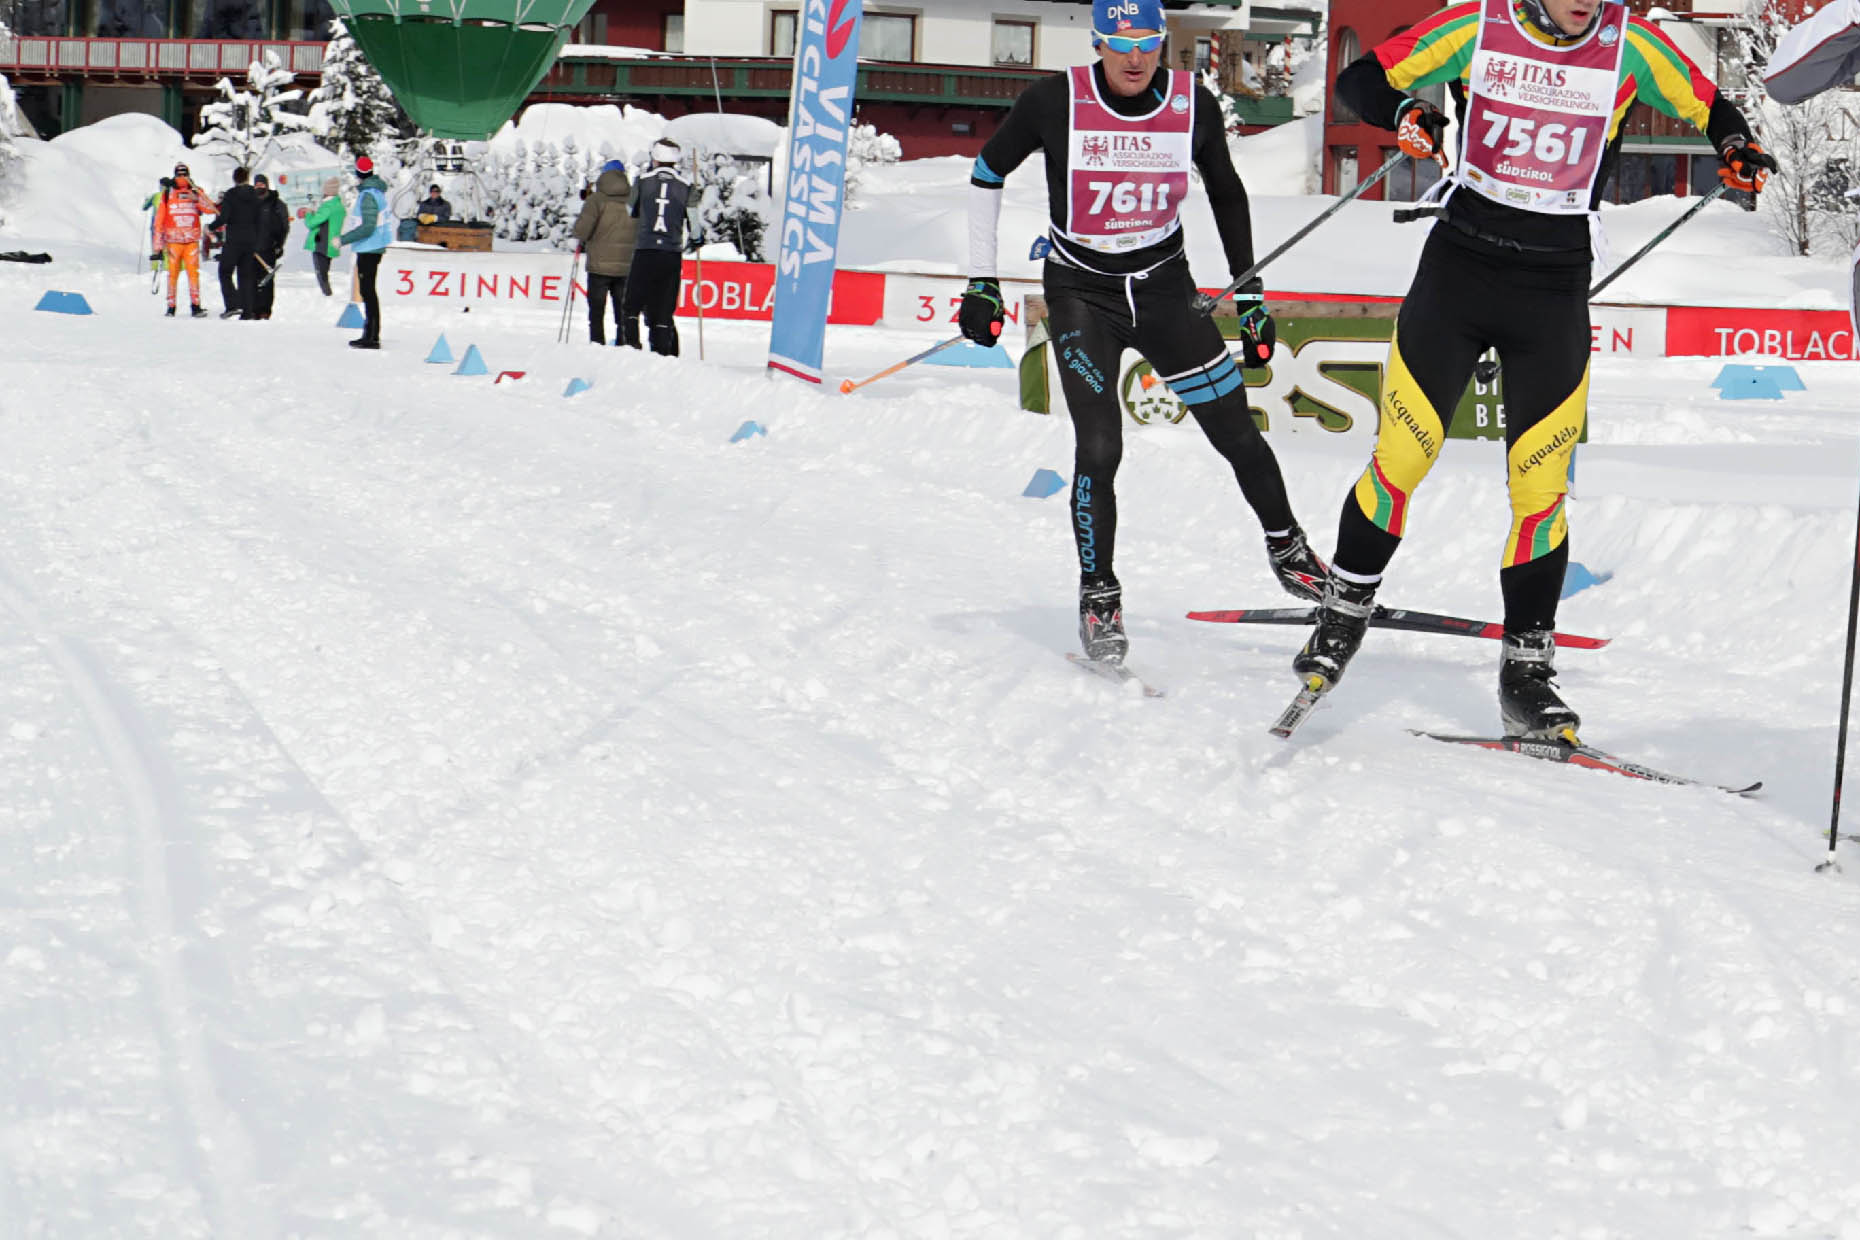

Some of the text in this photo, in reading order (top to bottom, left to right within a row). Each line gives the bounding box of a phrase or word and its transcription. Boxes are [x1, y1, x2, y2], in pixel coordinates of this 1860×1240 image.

[1519, 83, 1591, 101] ASSICURAZIONI
[1522, 63, 1566, 88] ITAS
[1113, 136, 1152, 151] ITAS
[1482, 109, 1588, 165] 7561
[779, 45, 821, 279] CLASSICS
[803, 85, 849, 265] VISMA
[654, 182, 669, 233] ITA
[1088, 181, 1170, 215] 7611
[396, 270, 414, 295] 3
[1077, 475, 1096, 573] salomon
[1520, 742, 1562, 760] ROSSIGNOL
